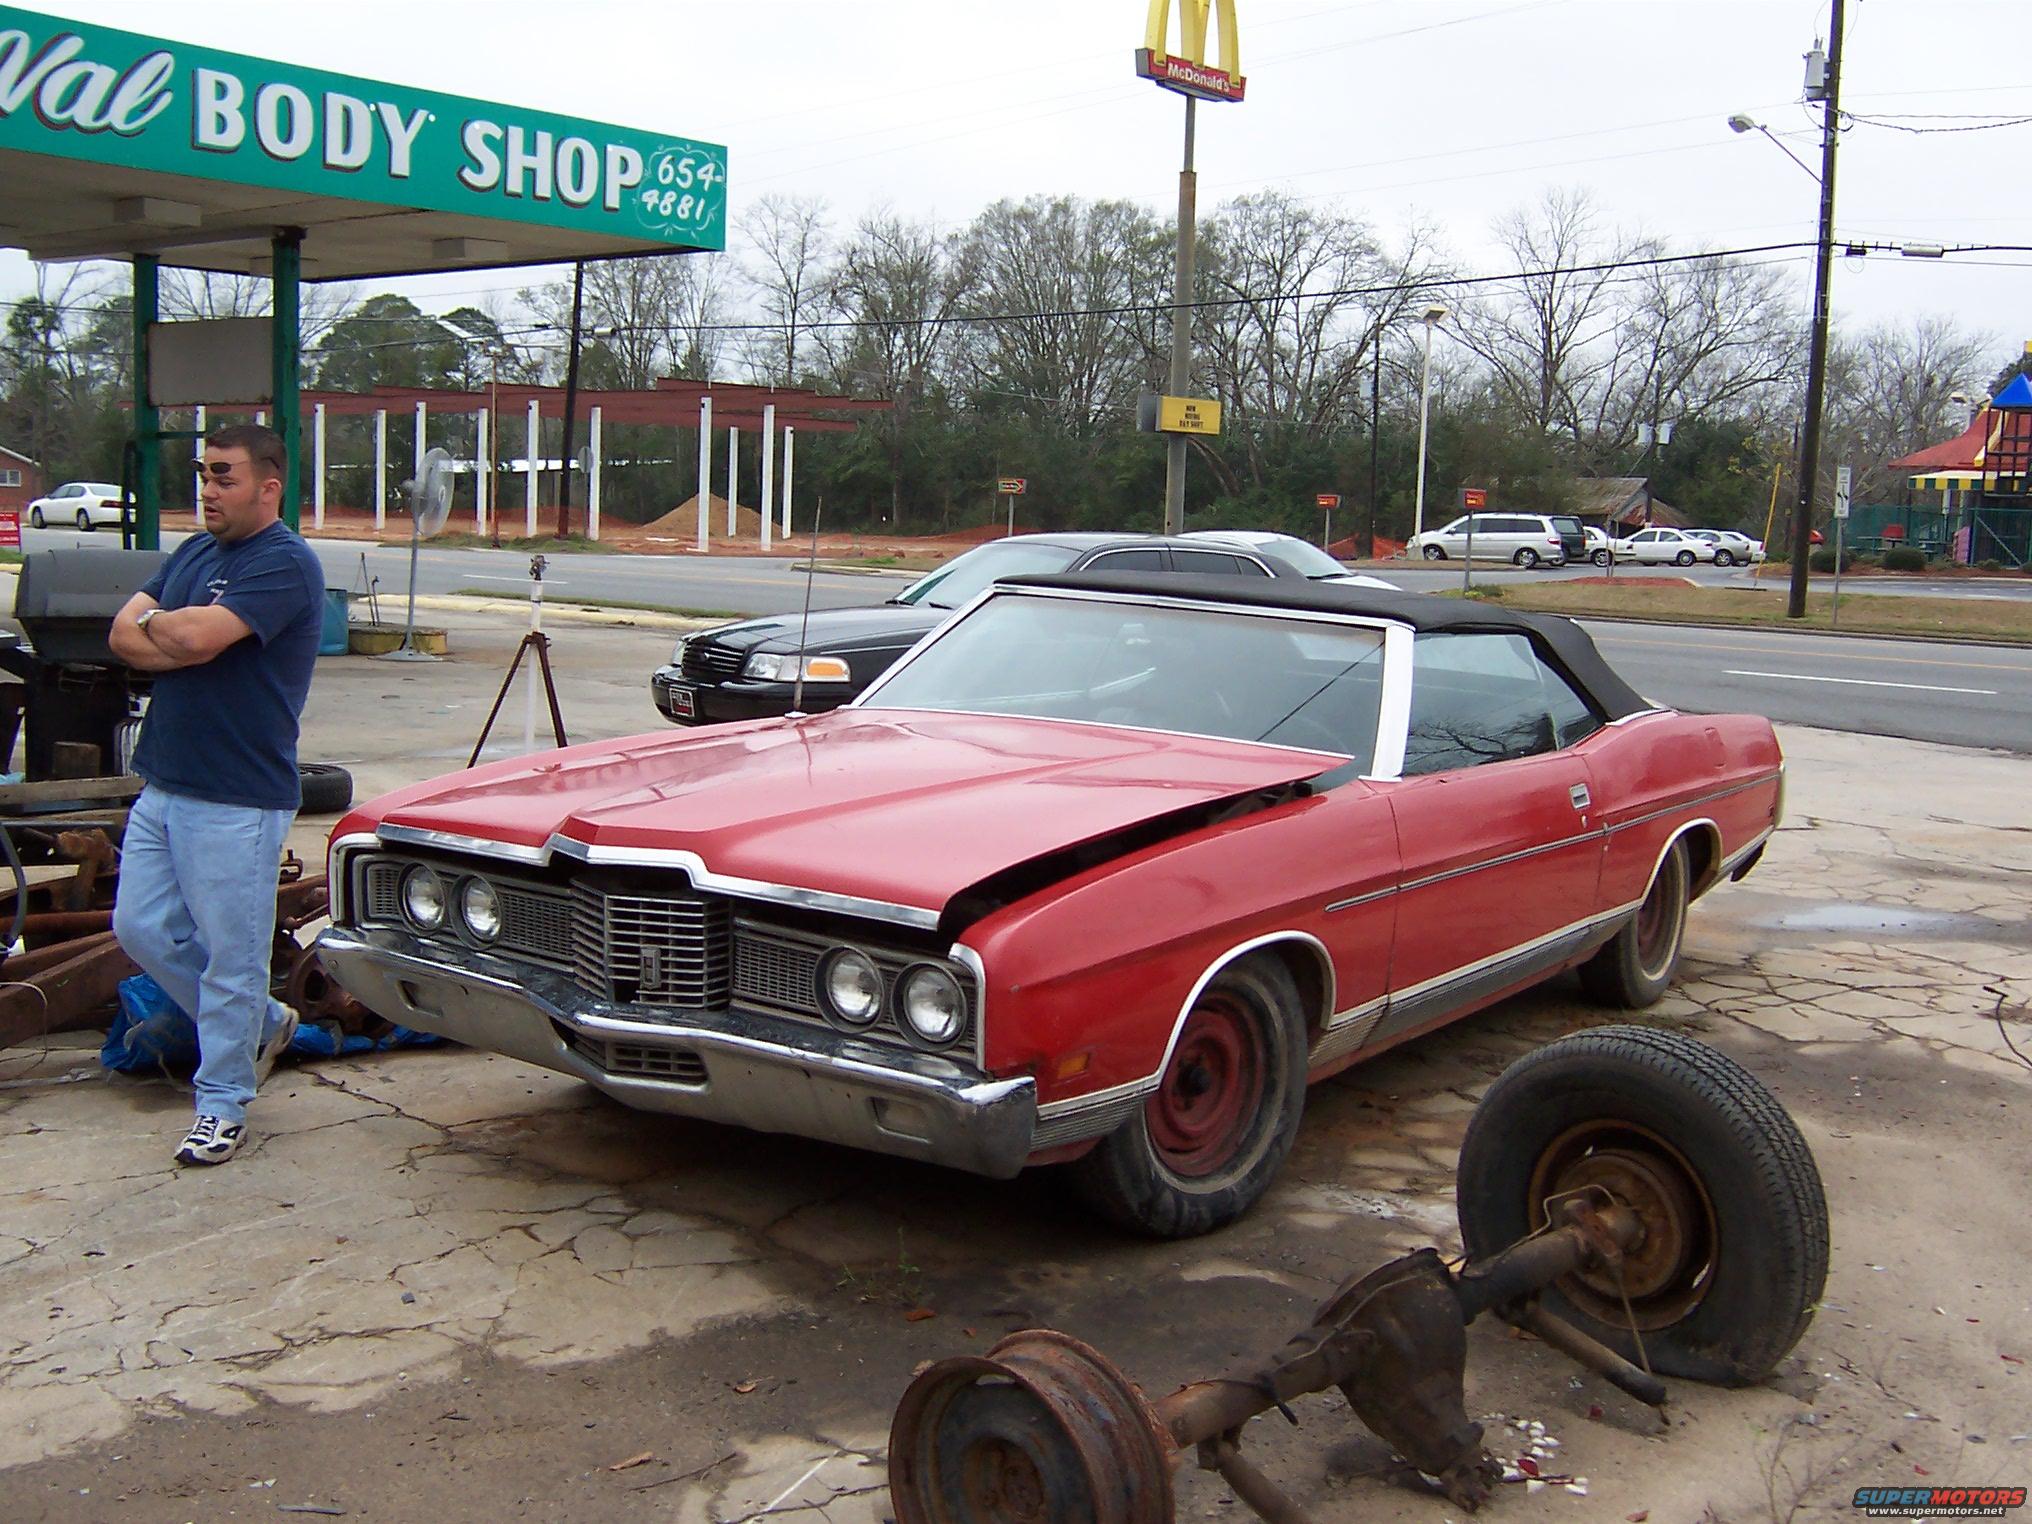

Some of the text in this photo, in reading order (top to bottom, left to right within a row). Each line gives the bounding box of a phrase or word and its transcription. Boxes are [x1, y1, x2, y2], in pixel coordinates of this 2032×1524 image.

[1167, 61, 1231, 92] McDonald's
[194, 67, 430, 178] BODY
[458, 119, 644, 210] SHOP
[640, 188, 706, 221] 4881
